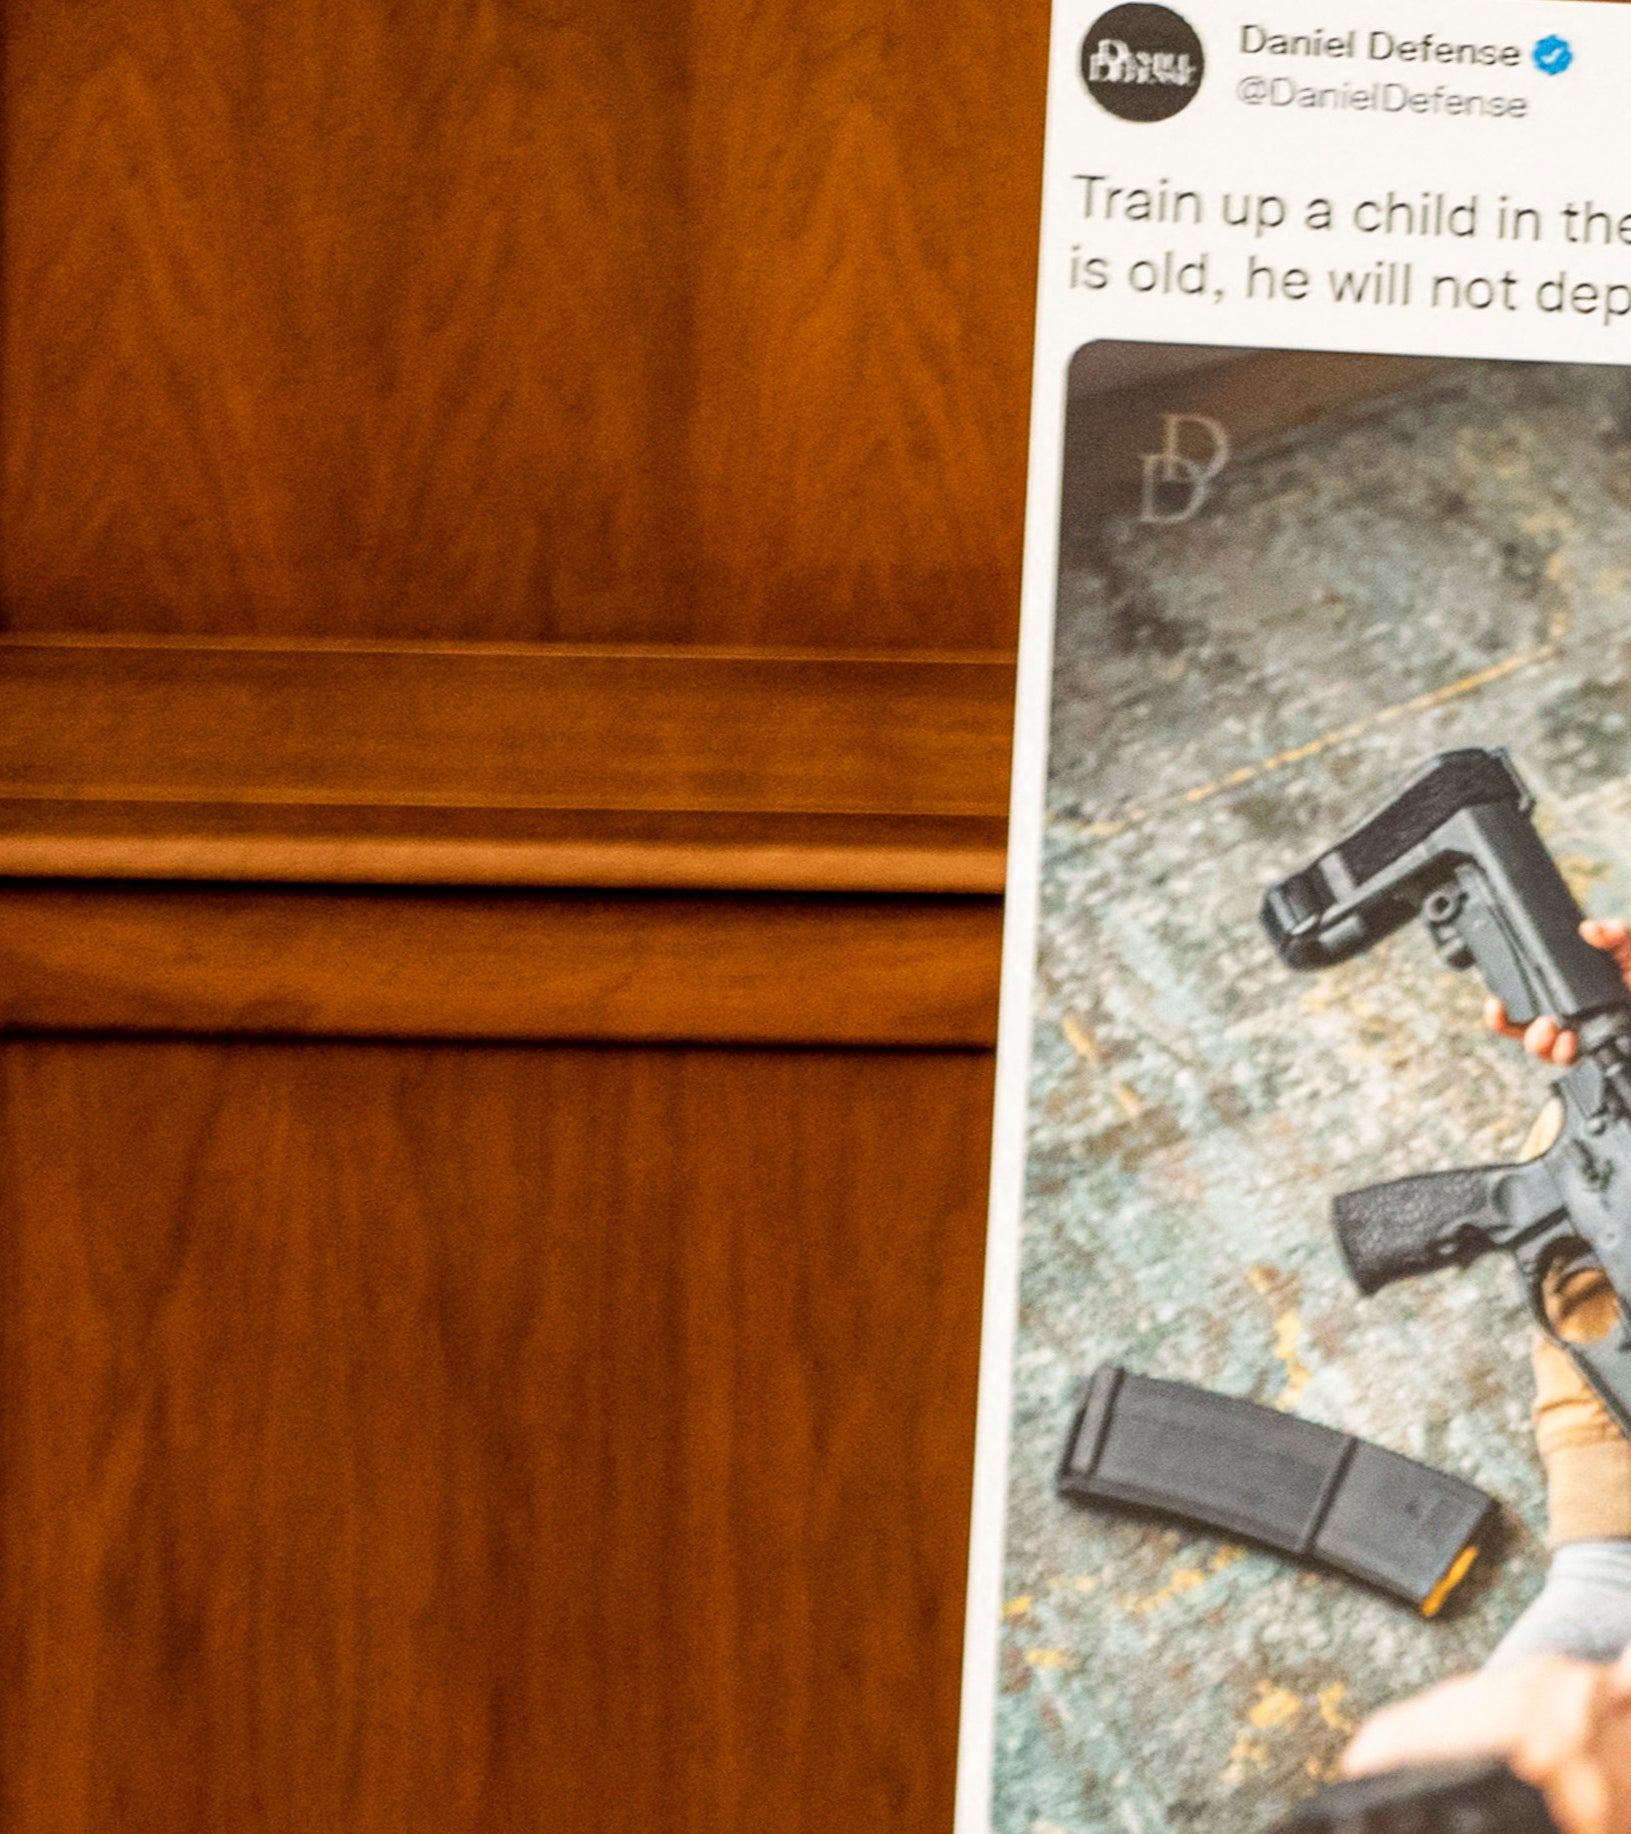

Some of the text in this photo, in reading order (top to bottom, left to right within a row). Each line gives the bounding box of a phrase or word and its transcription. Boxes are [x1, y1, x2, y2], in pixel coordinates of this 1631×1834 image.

[1239, 23, 1522, 68] Daniel Defense
[1236, 75, 1529, 120] @DanielDefense
[1073, 173, 1203, 225] Train
[1221, 192, 1288, 238] up
[1303, 197, 1334, 232] a
[1352, 190, 1479, 239] child
[1497, 194, 1542, 243] in
[1069, 243, 1110, 292] is
[1127, 249, 1226, 305] old,
[1245, 254, 1311, 302] he
[1327, 261, 1413, 307] will
[1430, 269, 1520, 313] not
